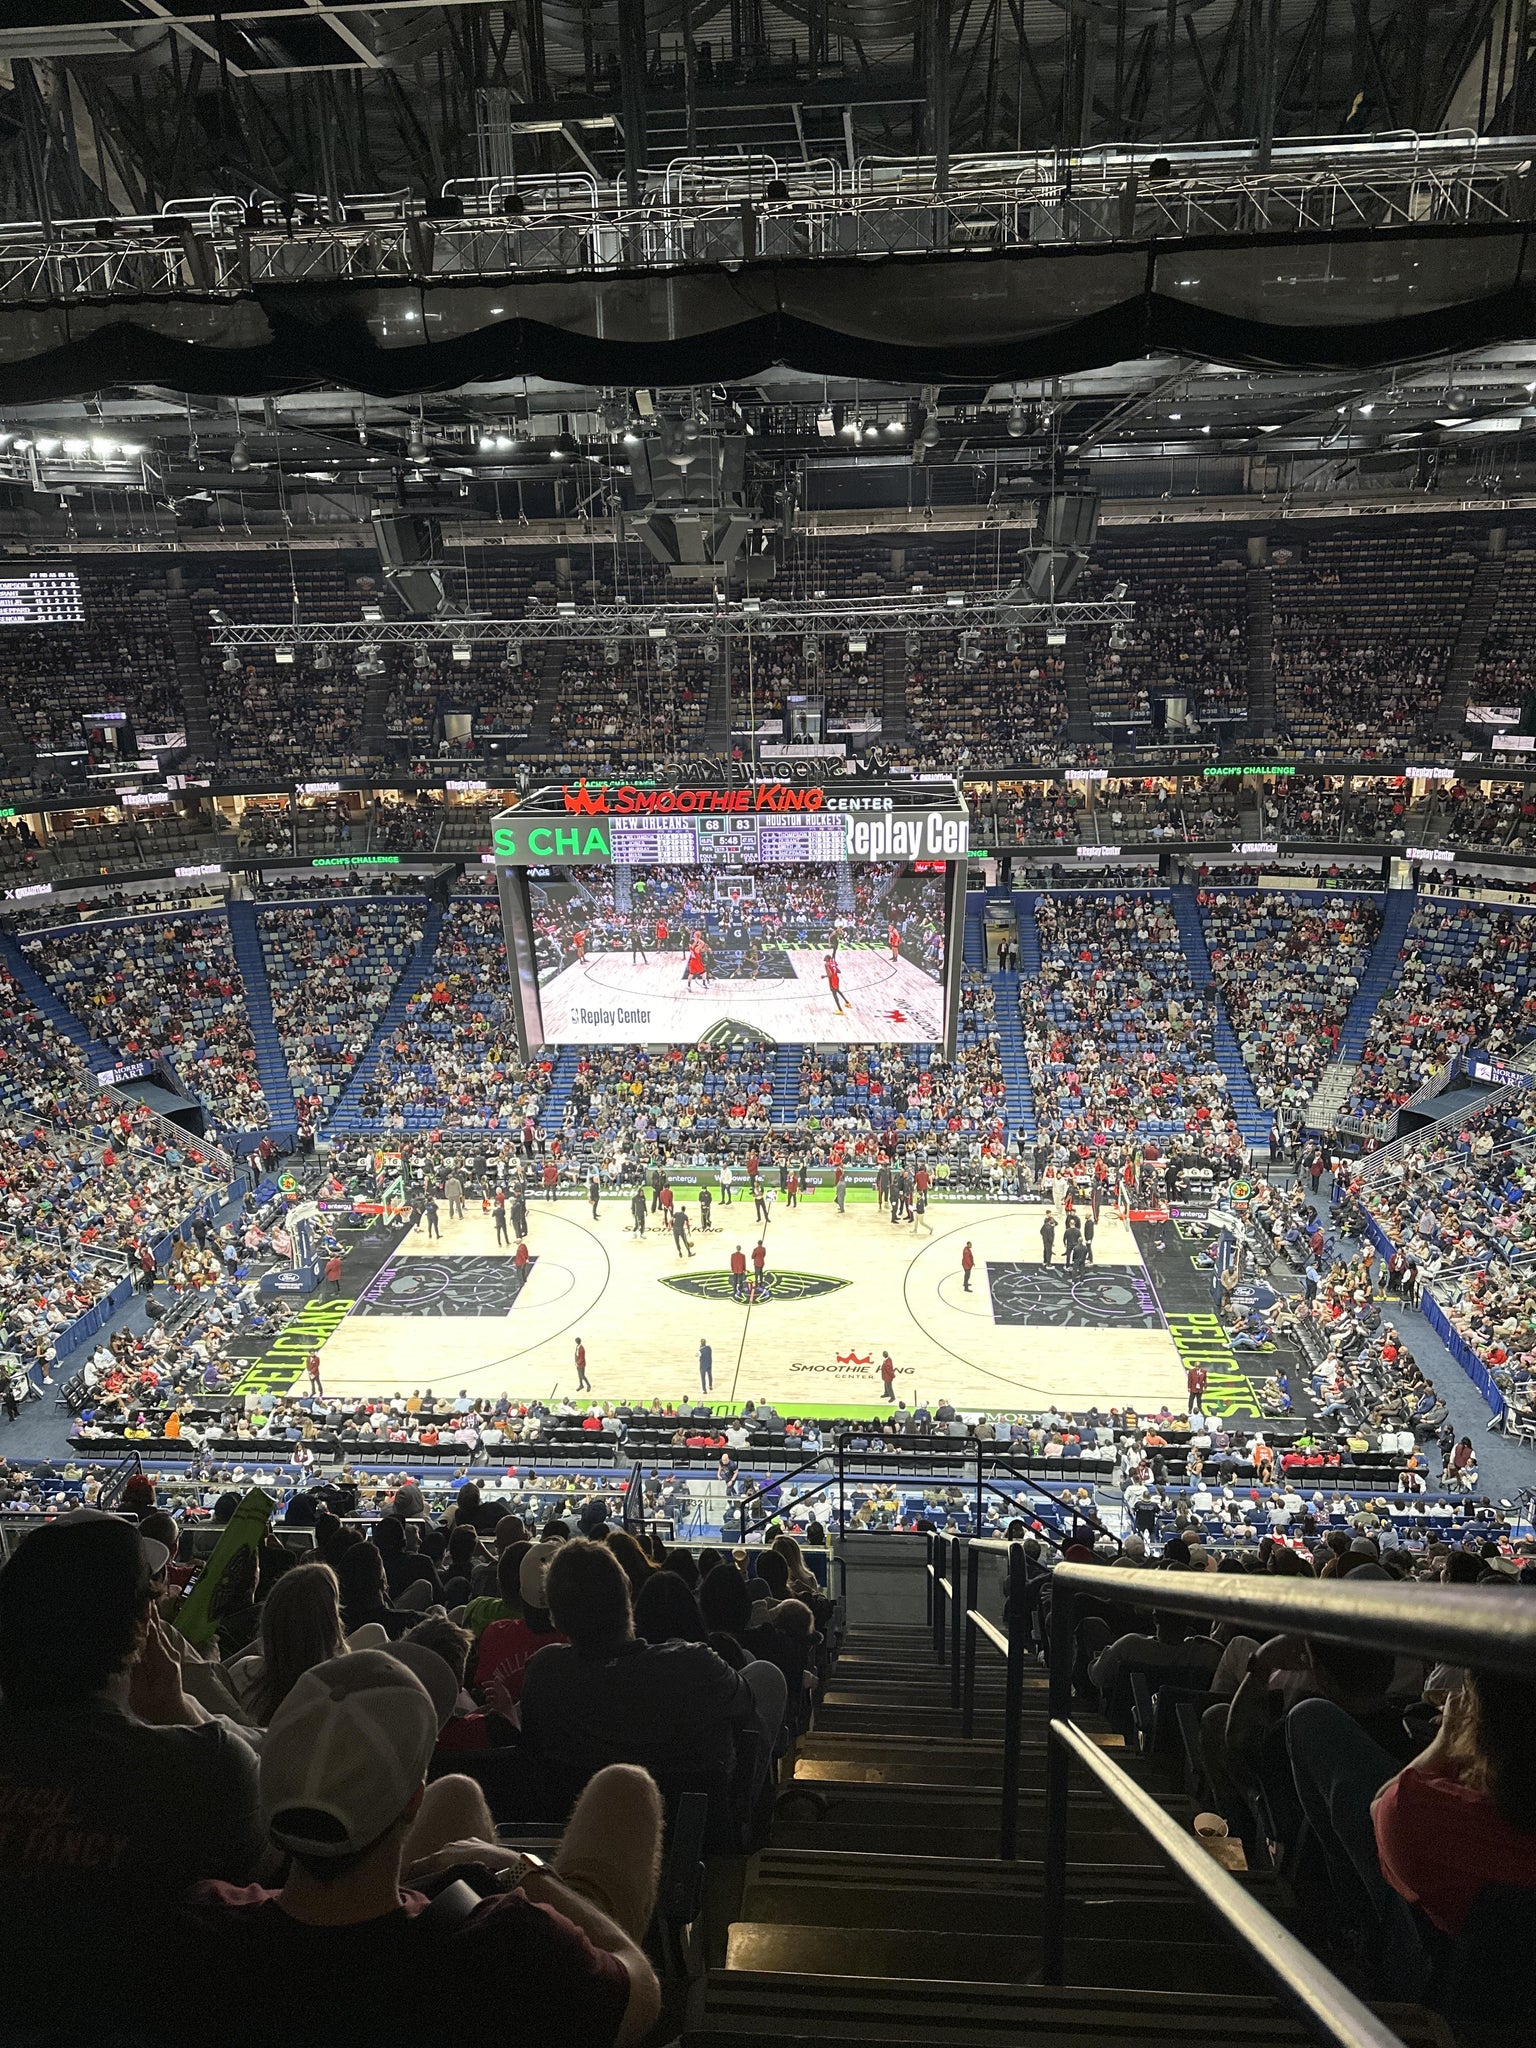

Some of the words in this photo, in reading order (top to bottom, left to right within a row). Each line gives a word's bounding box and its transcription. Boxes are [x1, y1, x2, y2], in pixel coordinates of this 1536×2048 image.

[1204, 768, 1242, 776] COACH'S
[1244, 766, 1295, 775] CHALLENGE
[1412, 767, 1432, 779] Replay
[1434, 768, 1455, 778] Center
[615, 786, 752, 813] SMOOTHIE
[827, 798, 894, 810] CENTER
[615, 818, 638, 829] NEW
[642, 817, 689, 829] ORLEANS
[706, 820, 720, 830] 68
[736, 820, 750, 830] 83
[766, 814, 802, 826] HOUSTON
[806, 814, 842, 826] ROCKETS
[494, 829, 516, 857] S
[528, 828, 610, 856] CHA
[720, 836, 739, 845] 5:48
[847, 813, 923, 862] Replay
[1412, 848, 1434, 860] Replay
[1434, 850, 1455, 861] Center
[312, 858, 350, 867] COACH'S
[351, 856, 399, 864] CHALLENGE
[581, 1008, 615, 1026] Replay
[618, 1007, 651, 1024] Center
[114, 1062, 144, 1075] MORRIS
[115, 1068, 144, 1081] BART
[668, 1176, 697, 1184] entergy
[1180, 1211, 1207, 1219] entergy
[234, 1300, 356, 1396] PELICANS
[789, 1363, 870, 1374] SMOOTHIE
[876, 1366, 916, 1375] KNG
